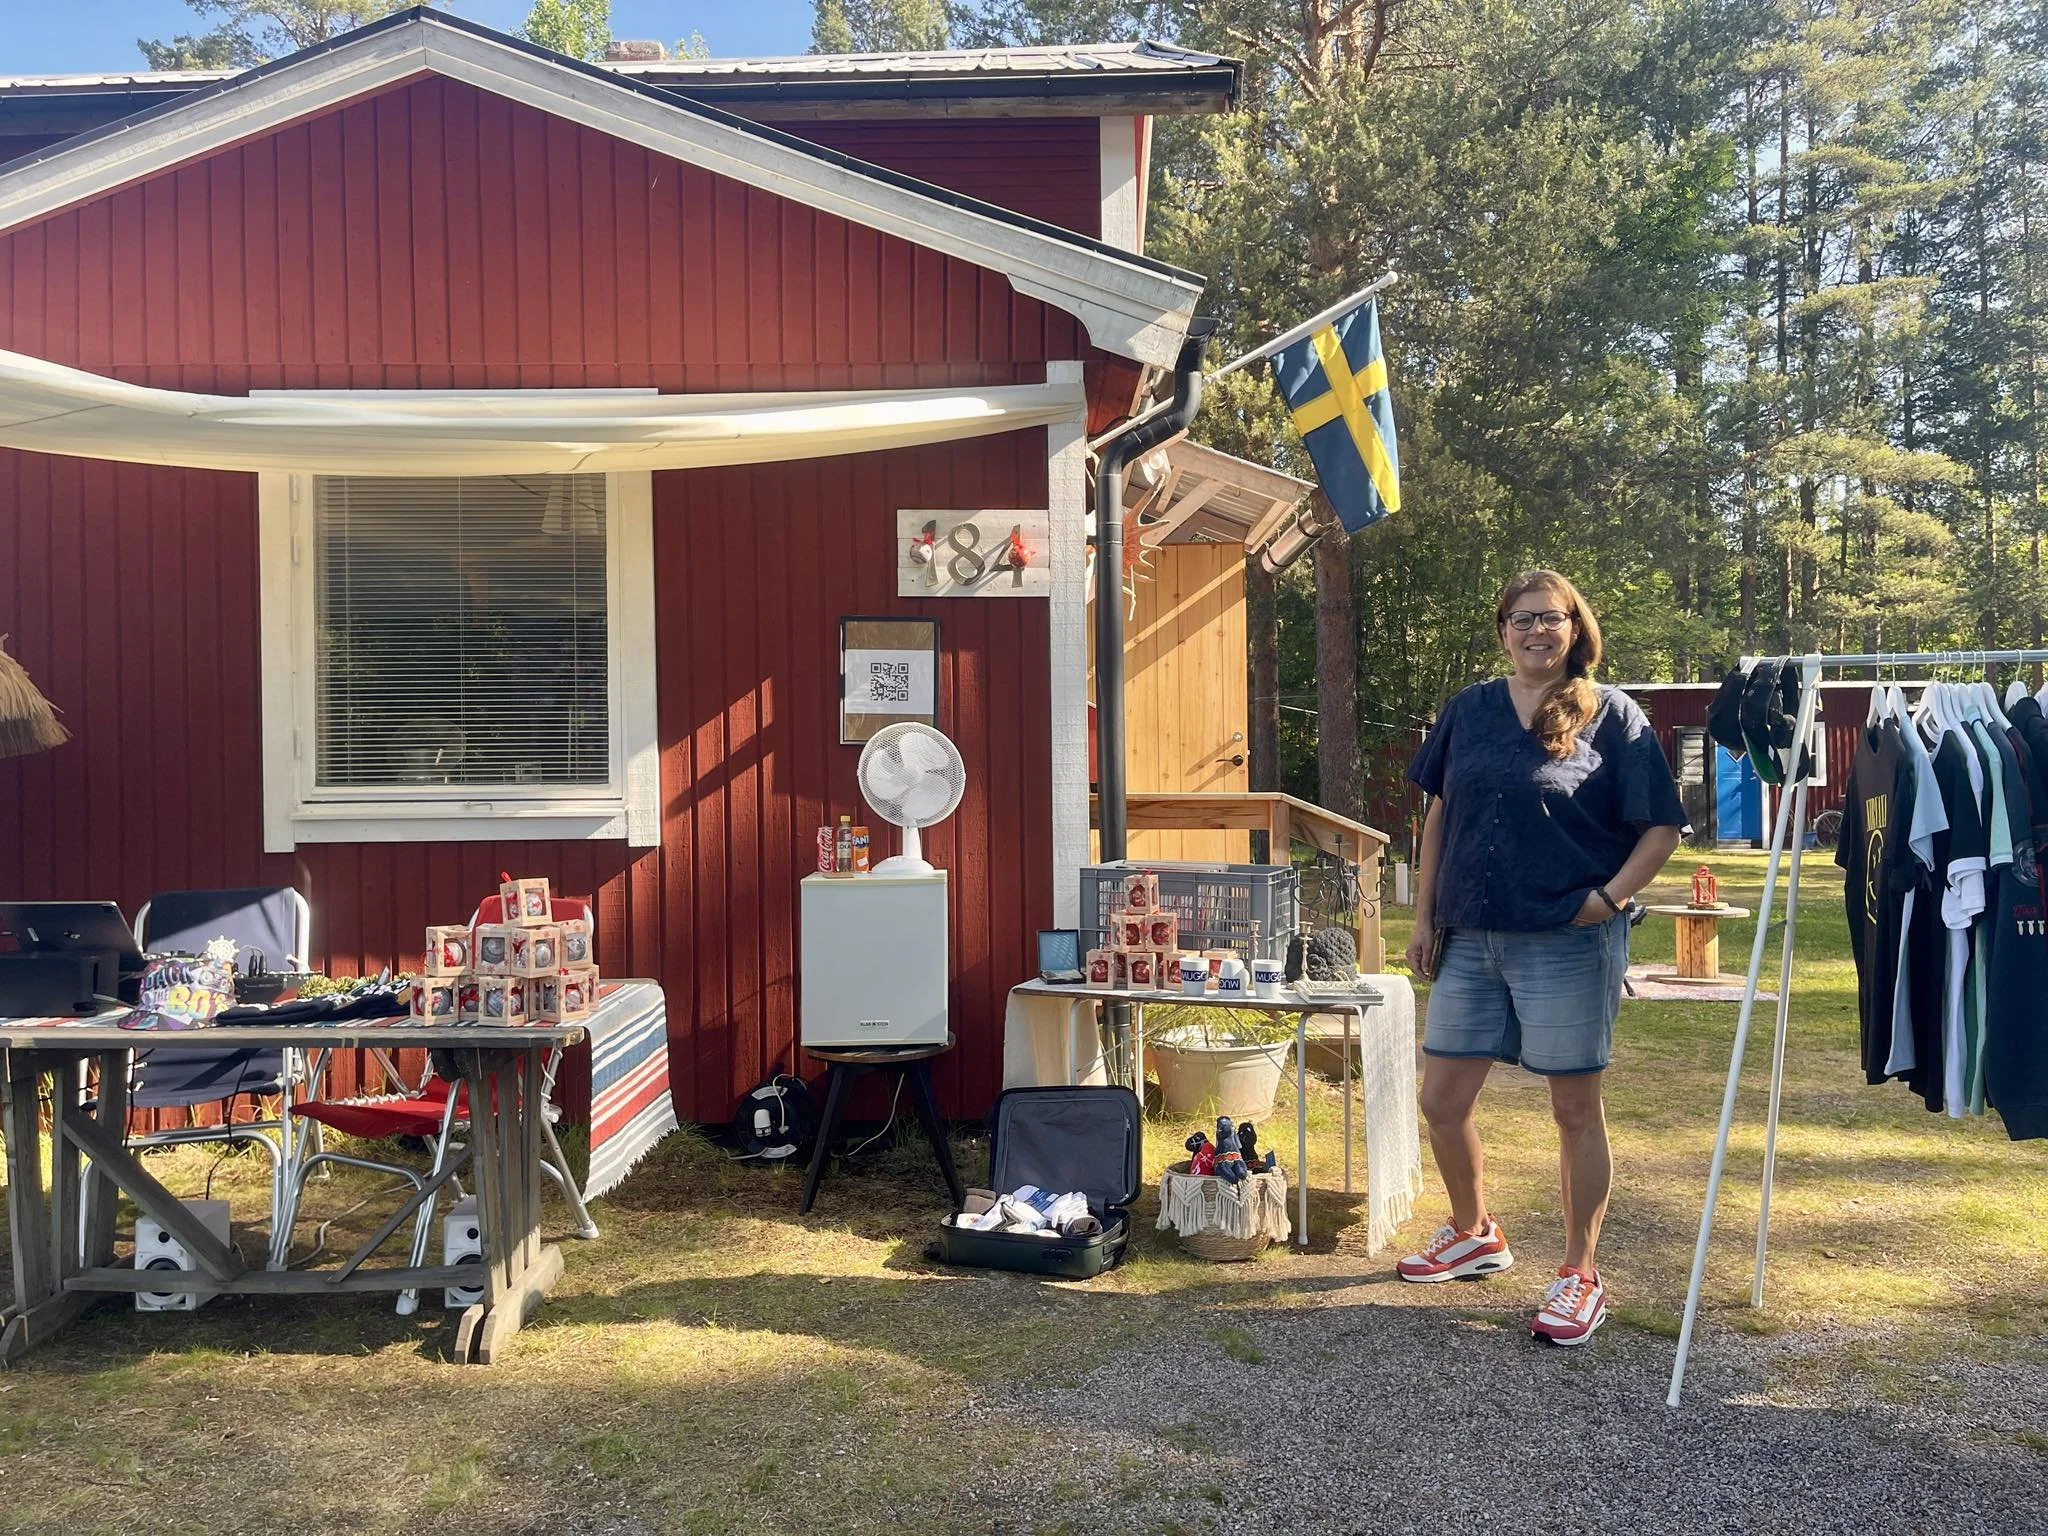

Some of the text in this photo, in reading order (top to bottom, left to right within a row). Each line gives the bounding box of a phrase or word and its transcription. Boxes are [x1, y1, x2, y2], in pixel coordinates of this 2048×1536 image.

[921, 519, 1025, 588] 184
[852, 834, 869, 845] FANT
[1219, 979, 1239, 989] MUG
